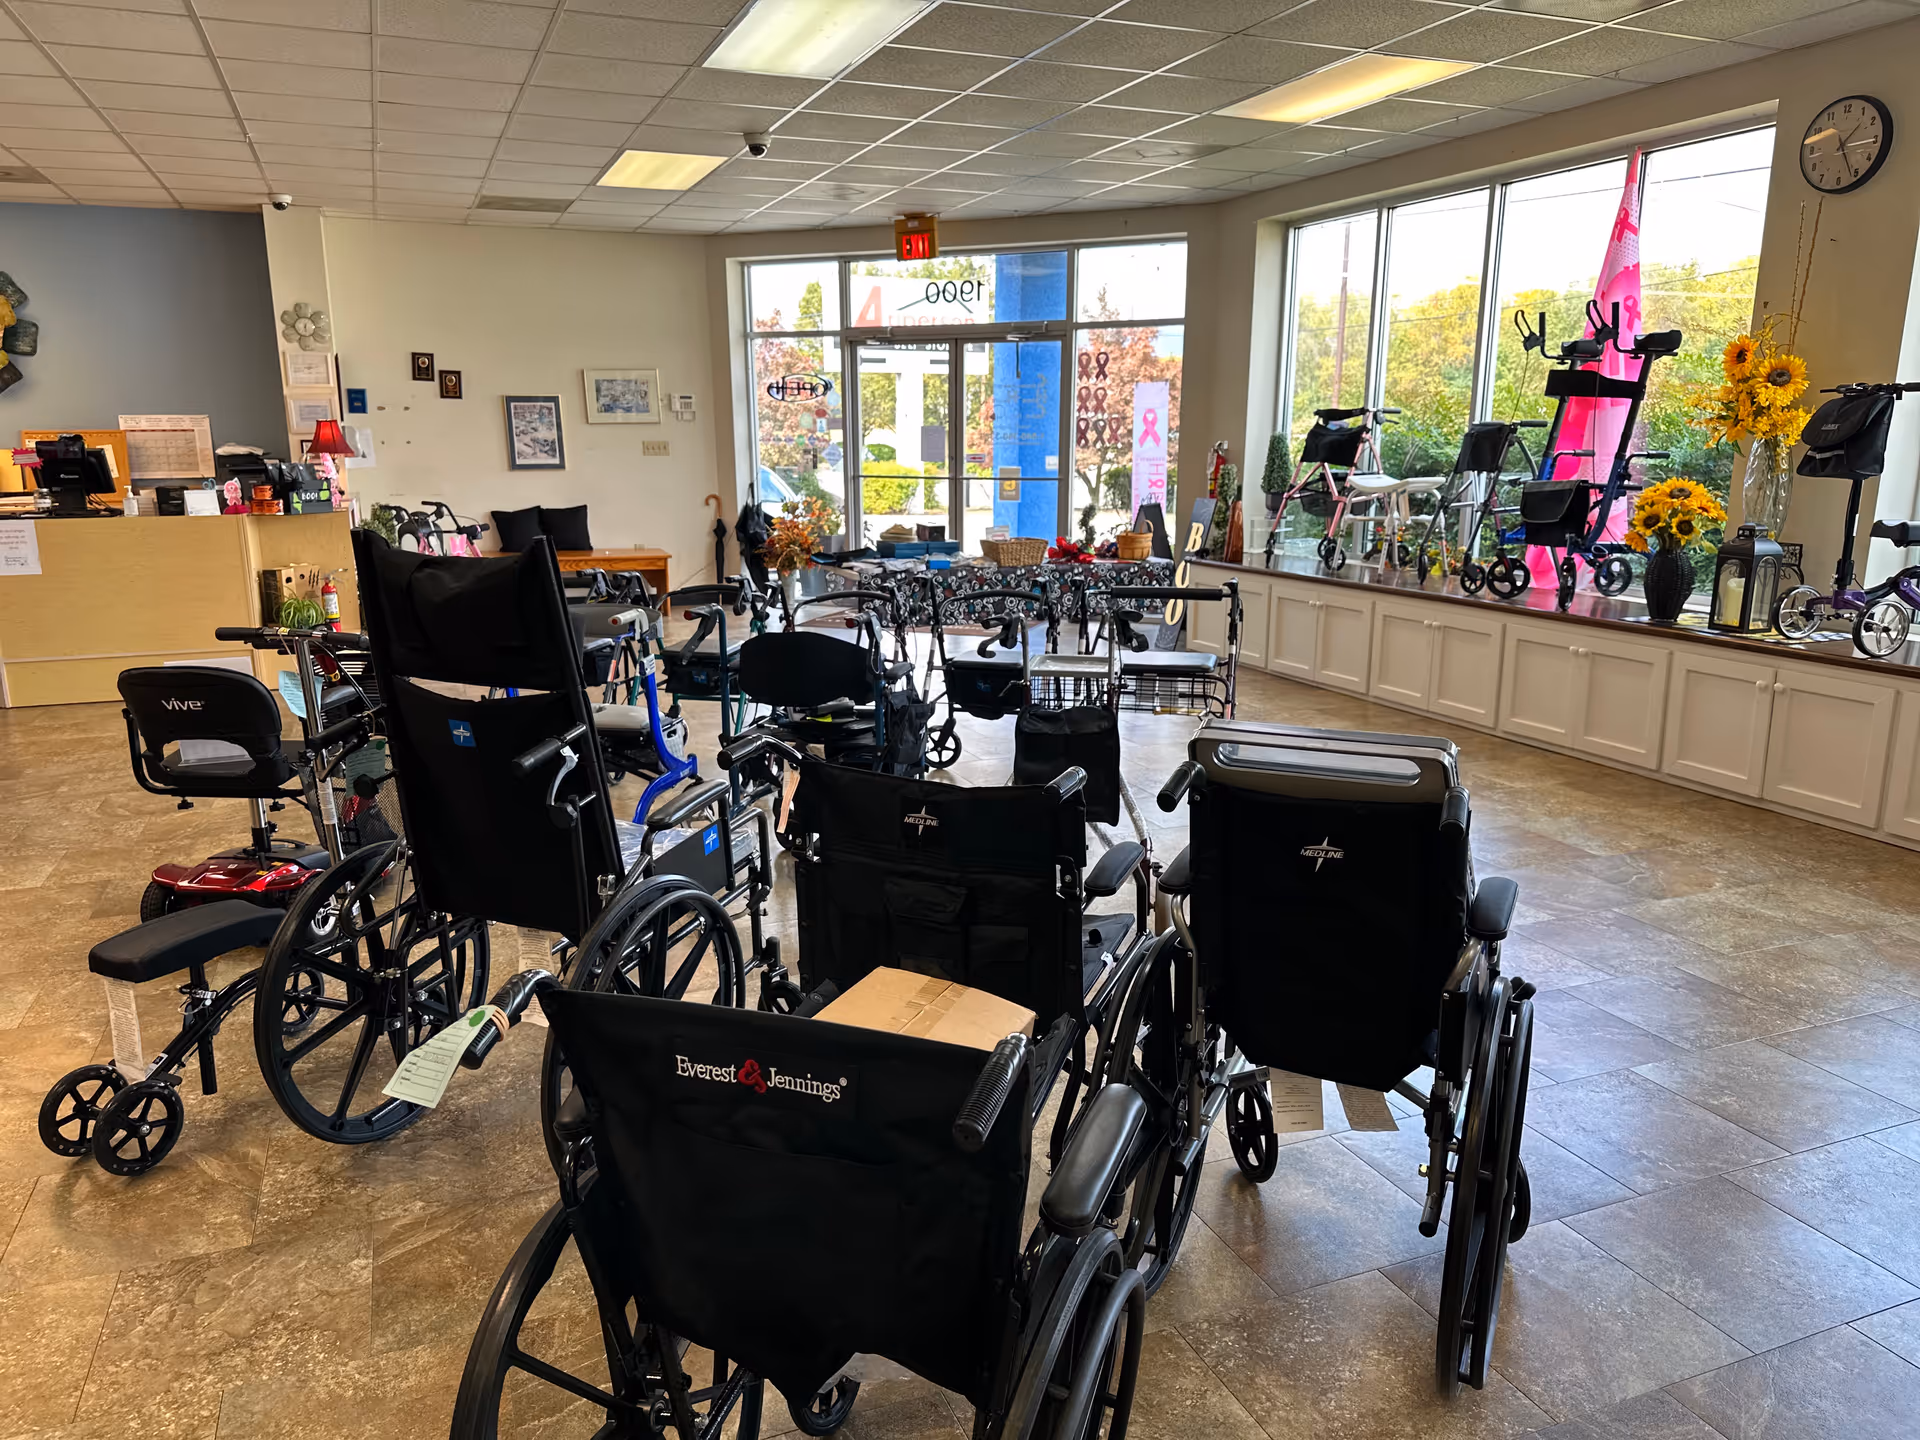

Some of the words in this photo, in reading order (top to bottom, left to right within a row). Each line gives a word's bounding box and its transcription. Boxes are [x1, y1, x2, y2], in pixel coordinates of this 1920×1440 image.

[1843, 103, 1853, 114] 12
[1860, 106, 1866, 117] 1
[1826, 111, 1836, 121] 11
[1870, 116, 1877, 126] 2
[1872, 135, 1879, 145] 3
[1866, 152, 1872, 162] 4
[1853, 168, 1859, 178] 5
[1819, 174, 1825, 184] 7
[1835, 176, 1842, 186] 6
[901, 232, 931, 260] EXIT
[160, 697, 203, 711] vive
[902, 815, 940, 828] MEDLINE
[1299, 847, 1345, 860] MEDLINE
[675, 1054, 738, 1084] Everest
[736, 1057, 768, 1095] &
